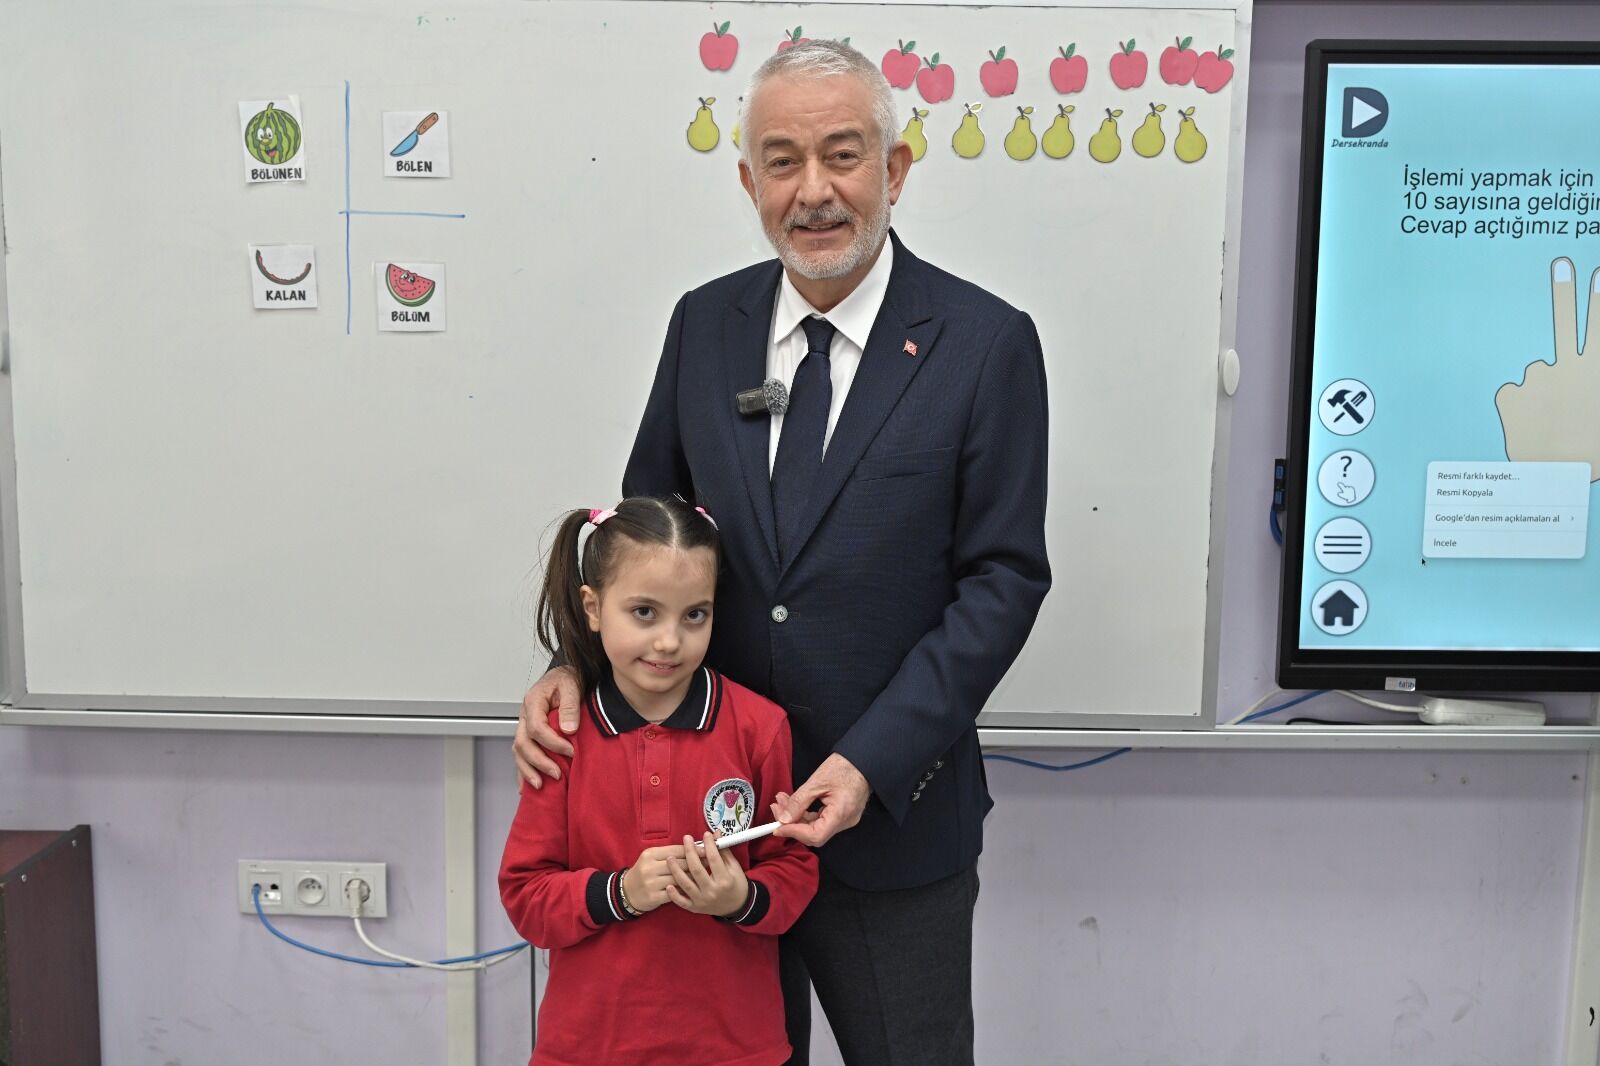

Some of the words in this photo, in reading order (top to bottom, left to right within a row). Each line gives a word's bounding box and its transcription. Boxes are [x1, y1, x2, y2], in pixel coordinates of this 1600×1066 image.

[1331, 138, 1389, 148] Dersekranda
[397, 161, 432, 172] BÖLEN
[251, 168, 301, 180] BÖLÜNEN
[1404, 164, 1463, 190] İşlemi
[1471, 169, 1552, 191] yapmak
[1560, 169, 1593, 191] için
[1404, 192, 1426, 209] 10
[1435, 196, 1519, 214] sayısına
[1401, 215, 1466, 238] Cevap
[1474, 216, 1568, 239] açtığımız
[266, 290, 306, 301] KALAN
[392, 311, 430, 322] BÖLÜM
[1437, 472, 1462, 480] Resmi
[1463, 472, 1484, 480] farklı
[1436, 488, 1461, 497] Resmi
[1462, 488, 1494, 498] Kopyala
[1435, 514, 1480, 524] Google'dan
[1481, 515, 1504, 523] resim
[1504, 514, 1551, 524] açıklamaları
[1552, 514, 1560, 523] al
[1433, 538, 1457, 547] İncele
